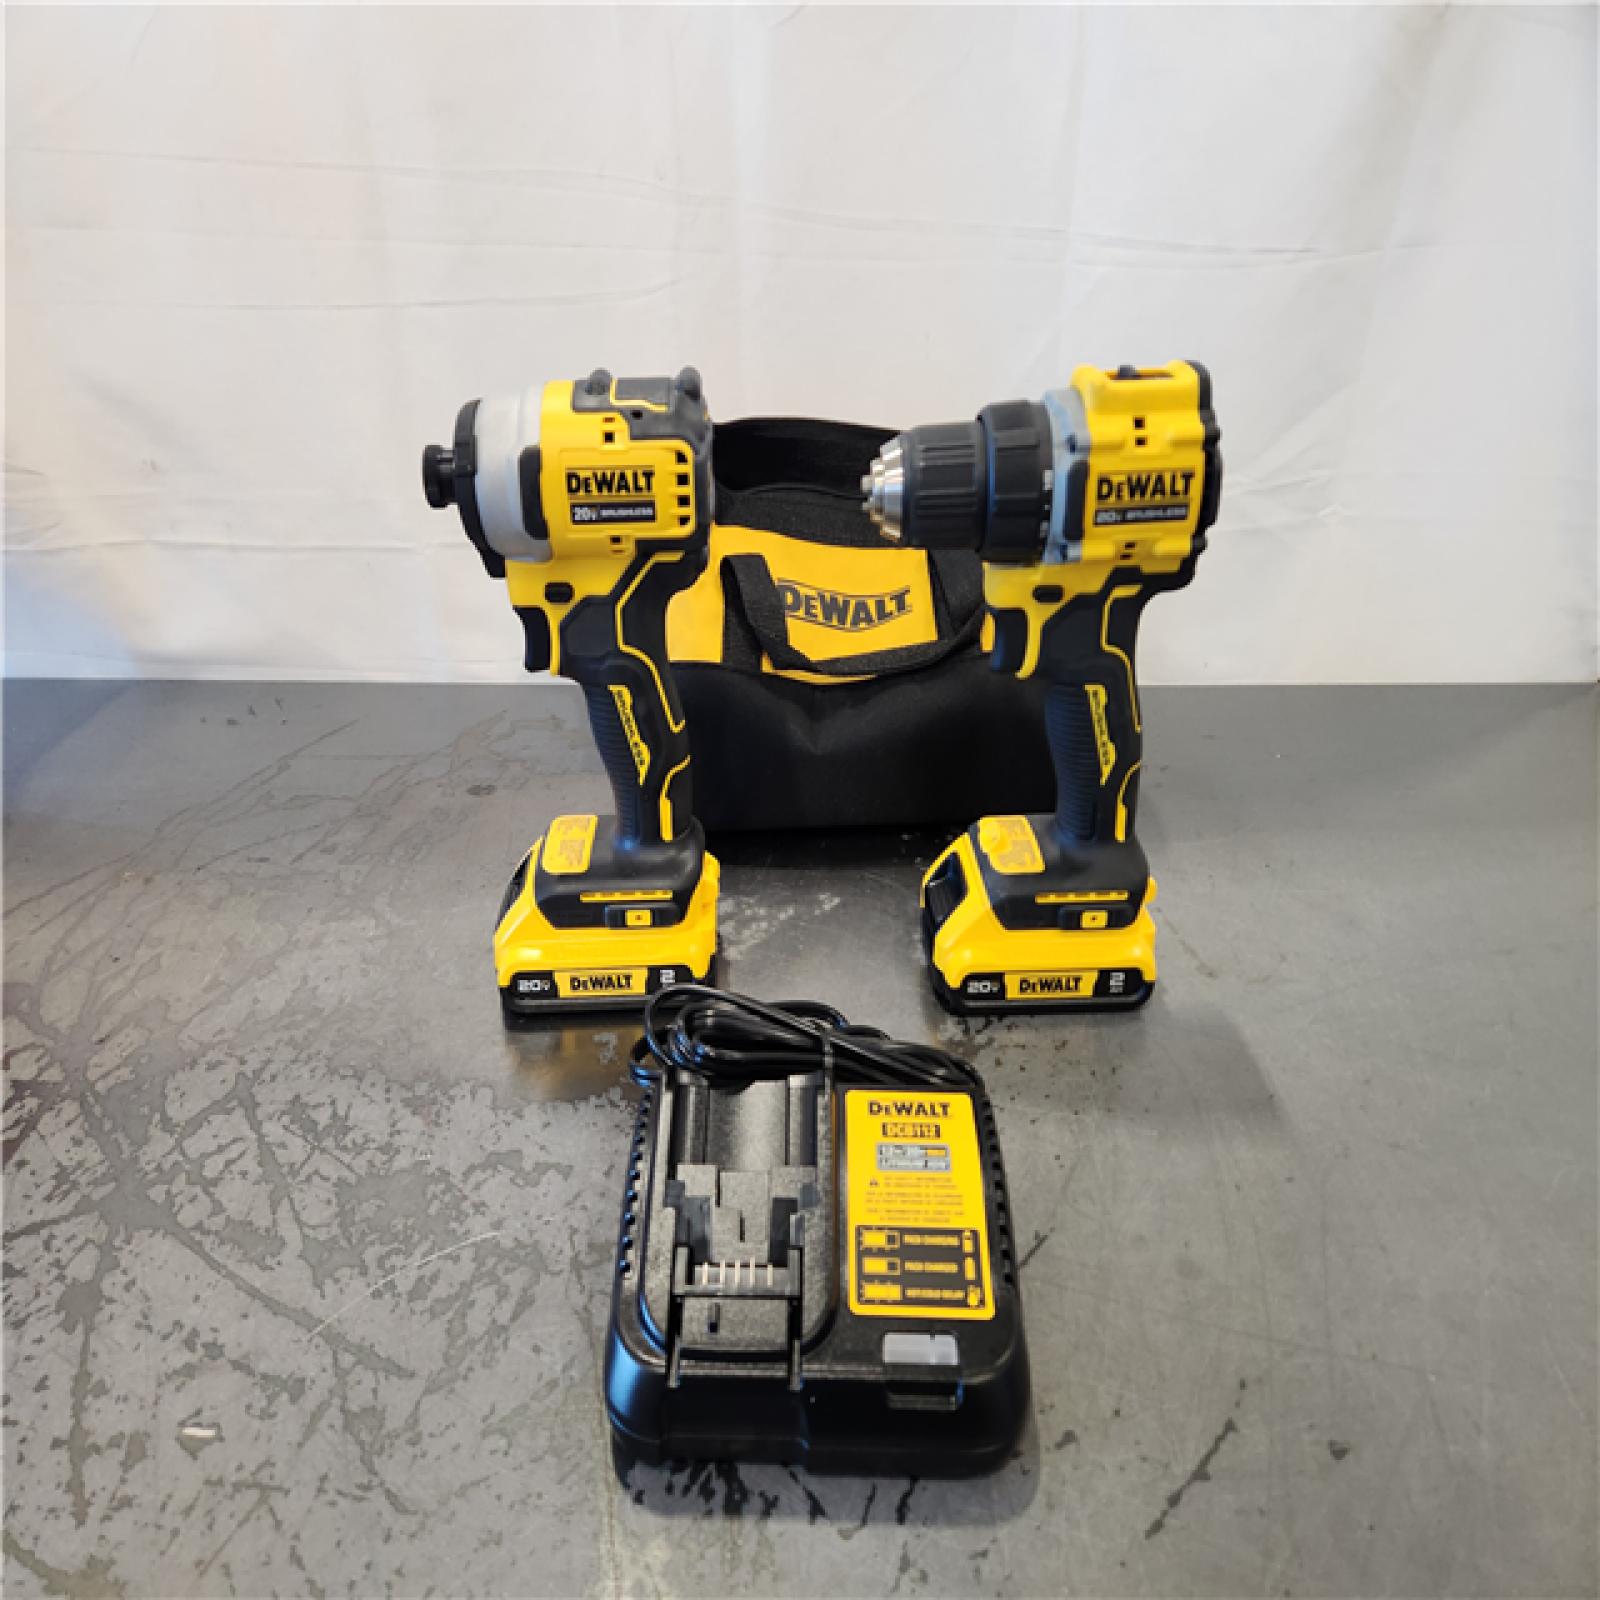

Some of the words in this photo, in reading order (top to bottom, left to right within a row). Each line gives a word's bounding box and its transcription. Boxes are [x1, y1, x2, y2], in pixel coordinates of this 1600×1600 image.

[566, 470, 655, 494] DEWALT
[1097, 472, 1195, 500] DEWALT
[569, 975, 632, 991] DEWALT
[1019, 976, 1082, 993] DEWALT
[869, 1101, 950, 1117] DEWALT
